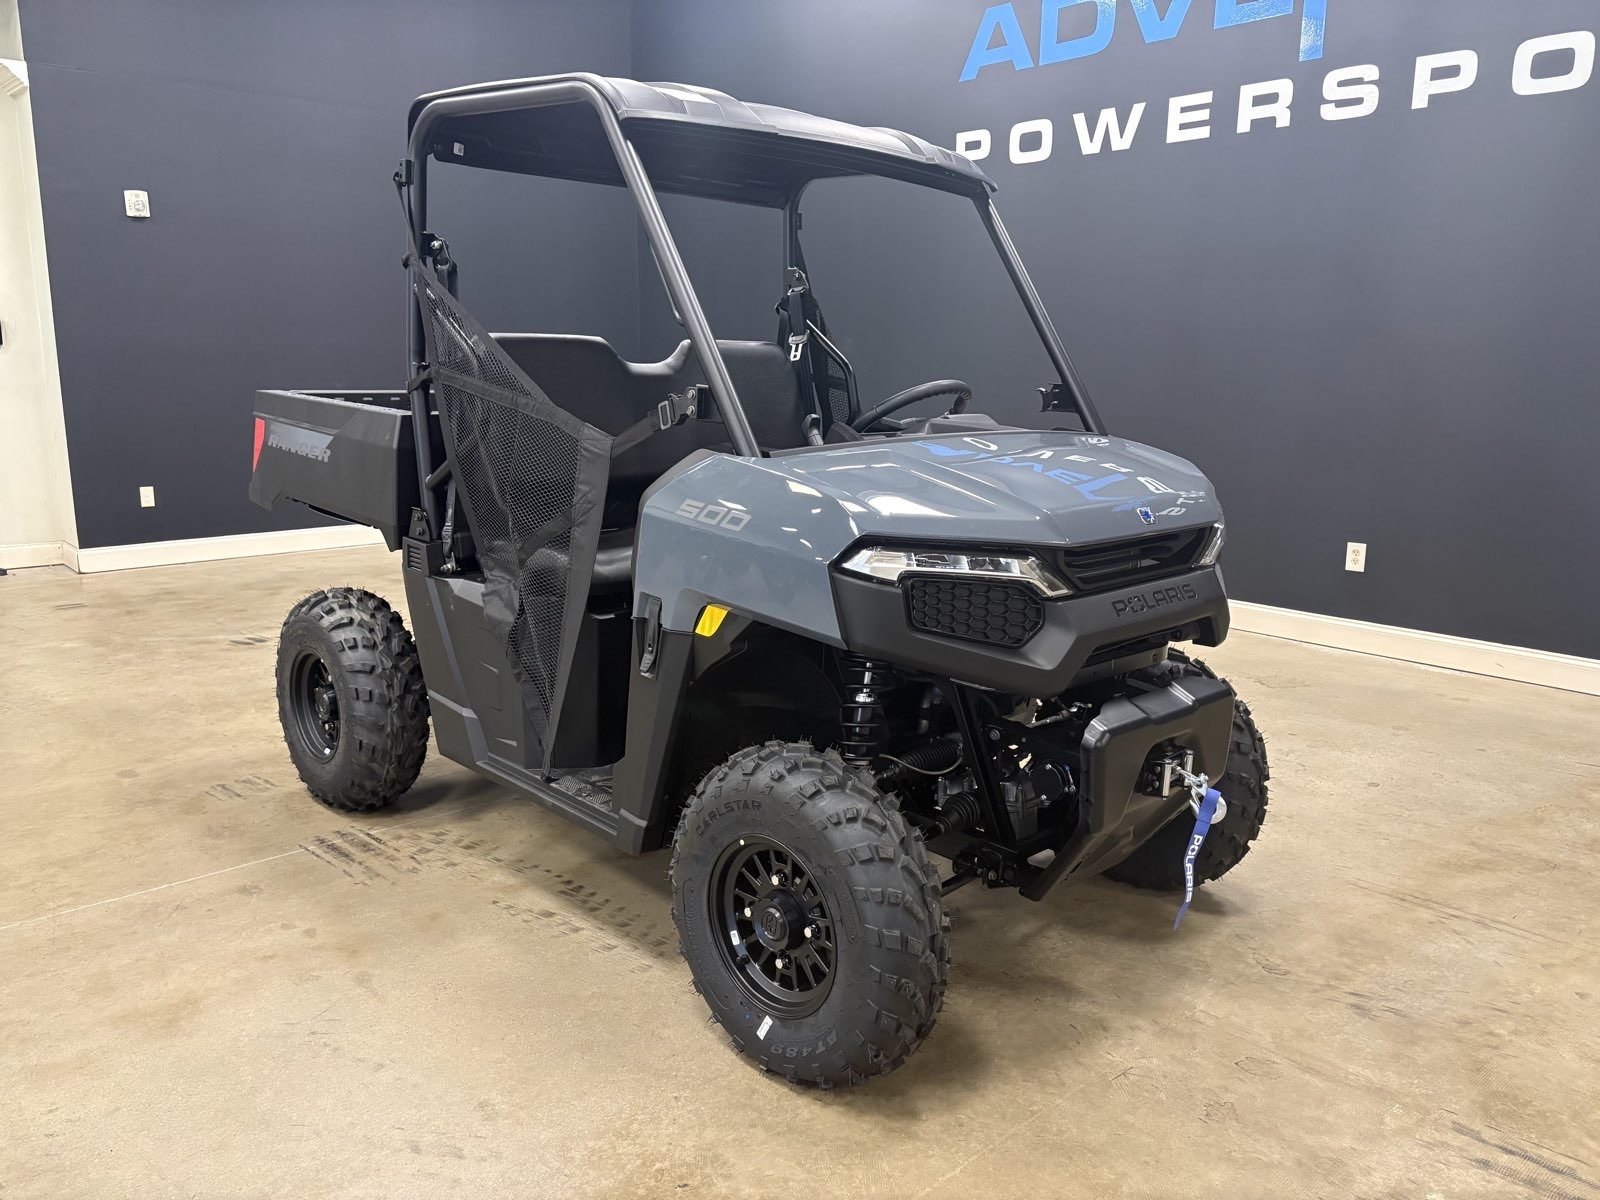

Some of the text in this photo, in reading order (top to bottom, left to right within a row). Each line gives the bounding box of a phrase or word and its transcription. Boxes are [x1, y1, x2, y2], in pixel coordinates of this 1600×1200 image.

[267, 433, 332, 463] RANGER
[675, 497, 752, 532] 500
[1110, 583, 1198, 618] POLARIS
[695, 799, 762, 838] CARLSTAR
[1184, 833, 1204, 903] POLARIS
